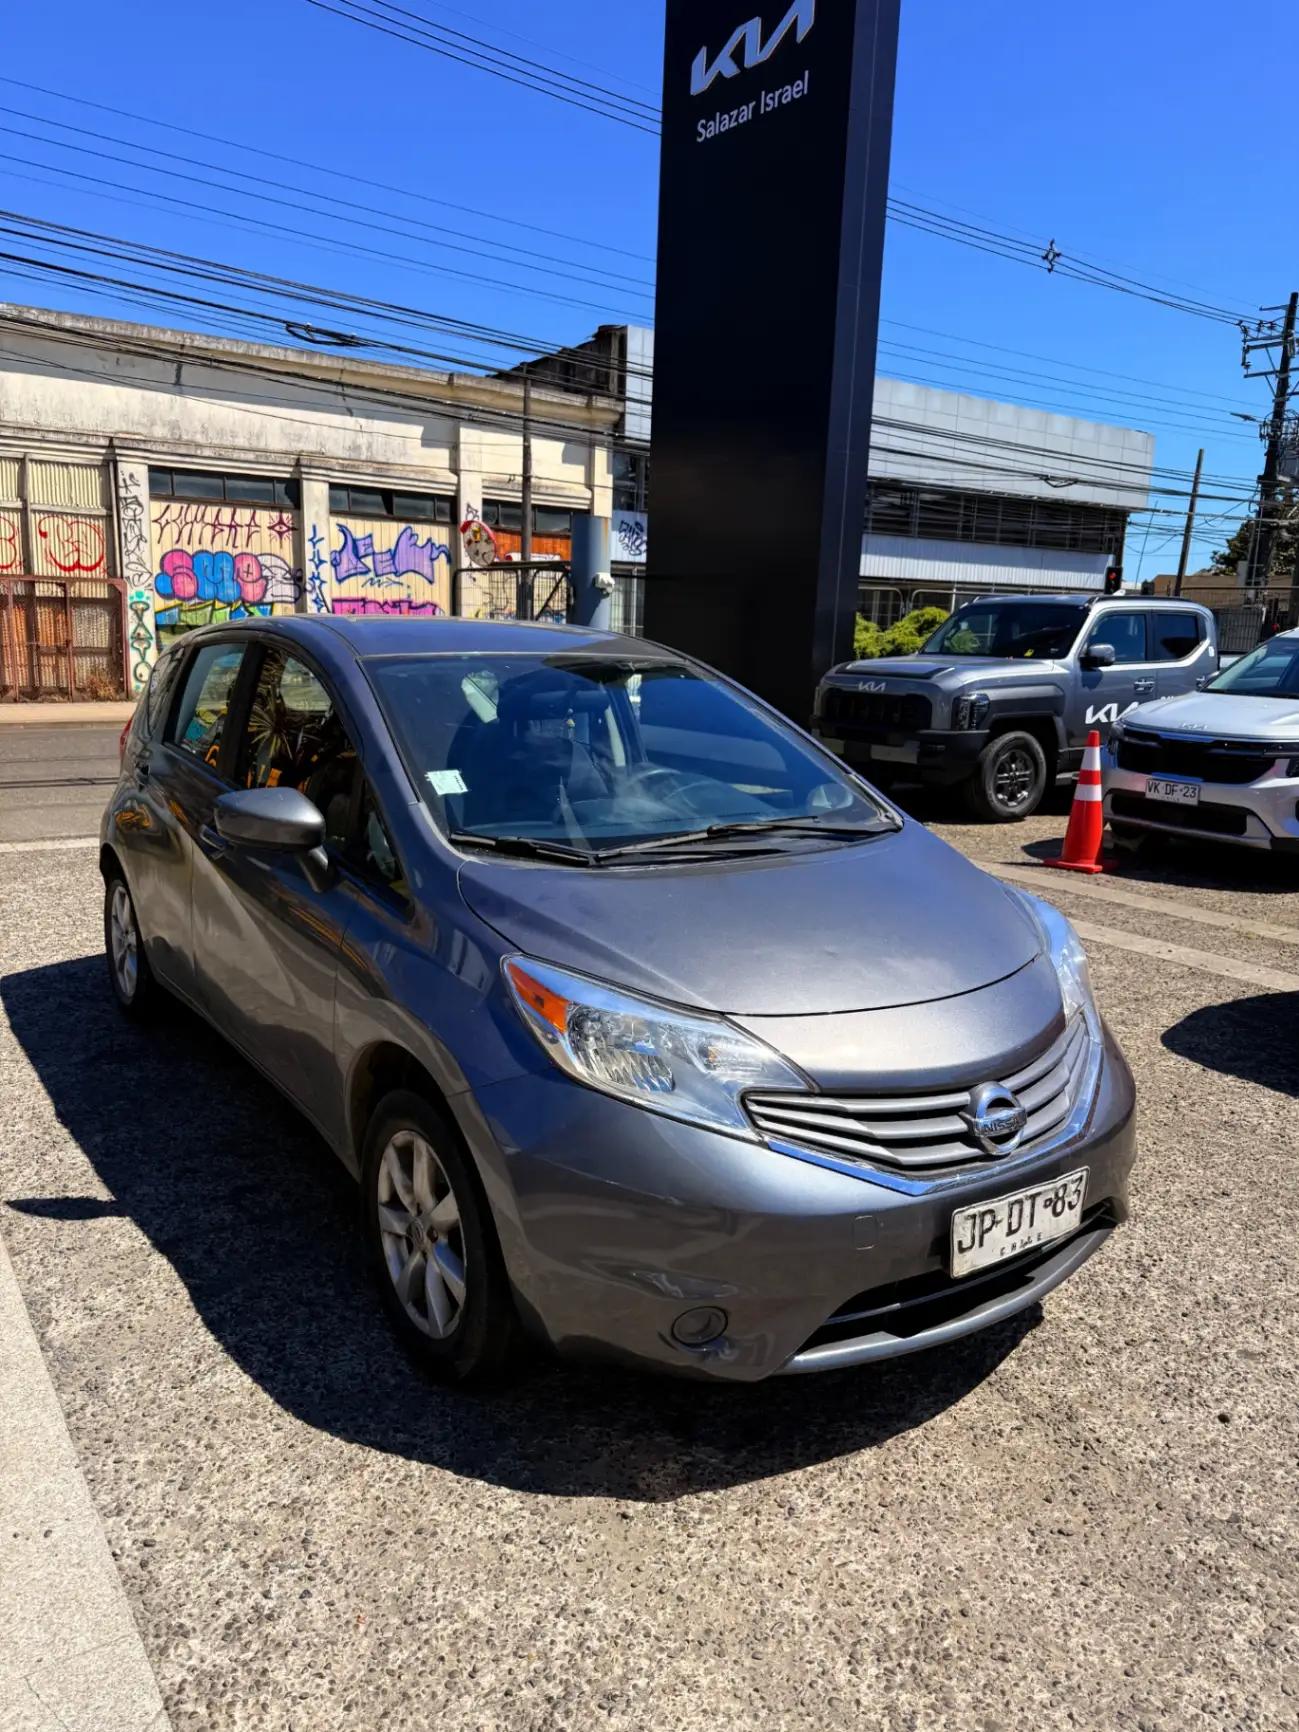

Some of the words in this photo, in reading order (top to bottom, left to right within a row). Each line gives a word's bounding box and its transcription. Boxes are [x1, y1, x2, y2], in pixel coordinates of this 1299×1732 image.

[690, 0, 815, 96] KIA
[696, 100, 756, 142] Salazar
[760, 70, 809, 114] Israel
[858, 681, 886, 692] KIA
